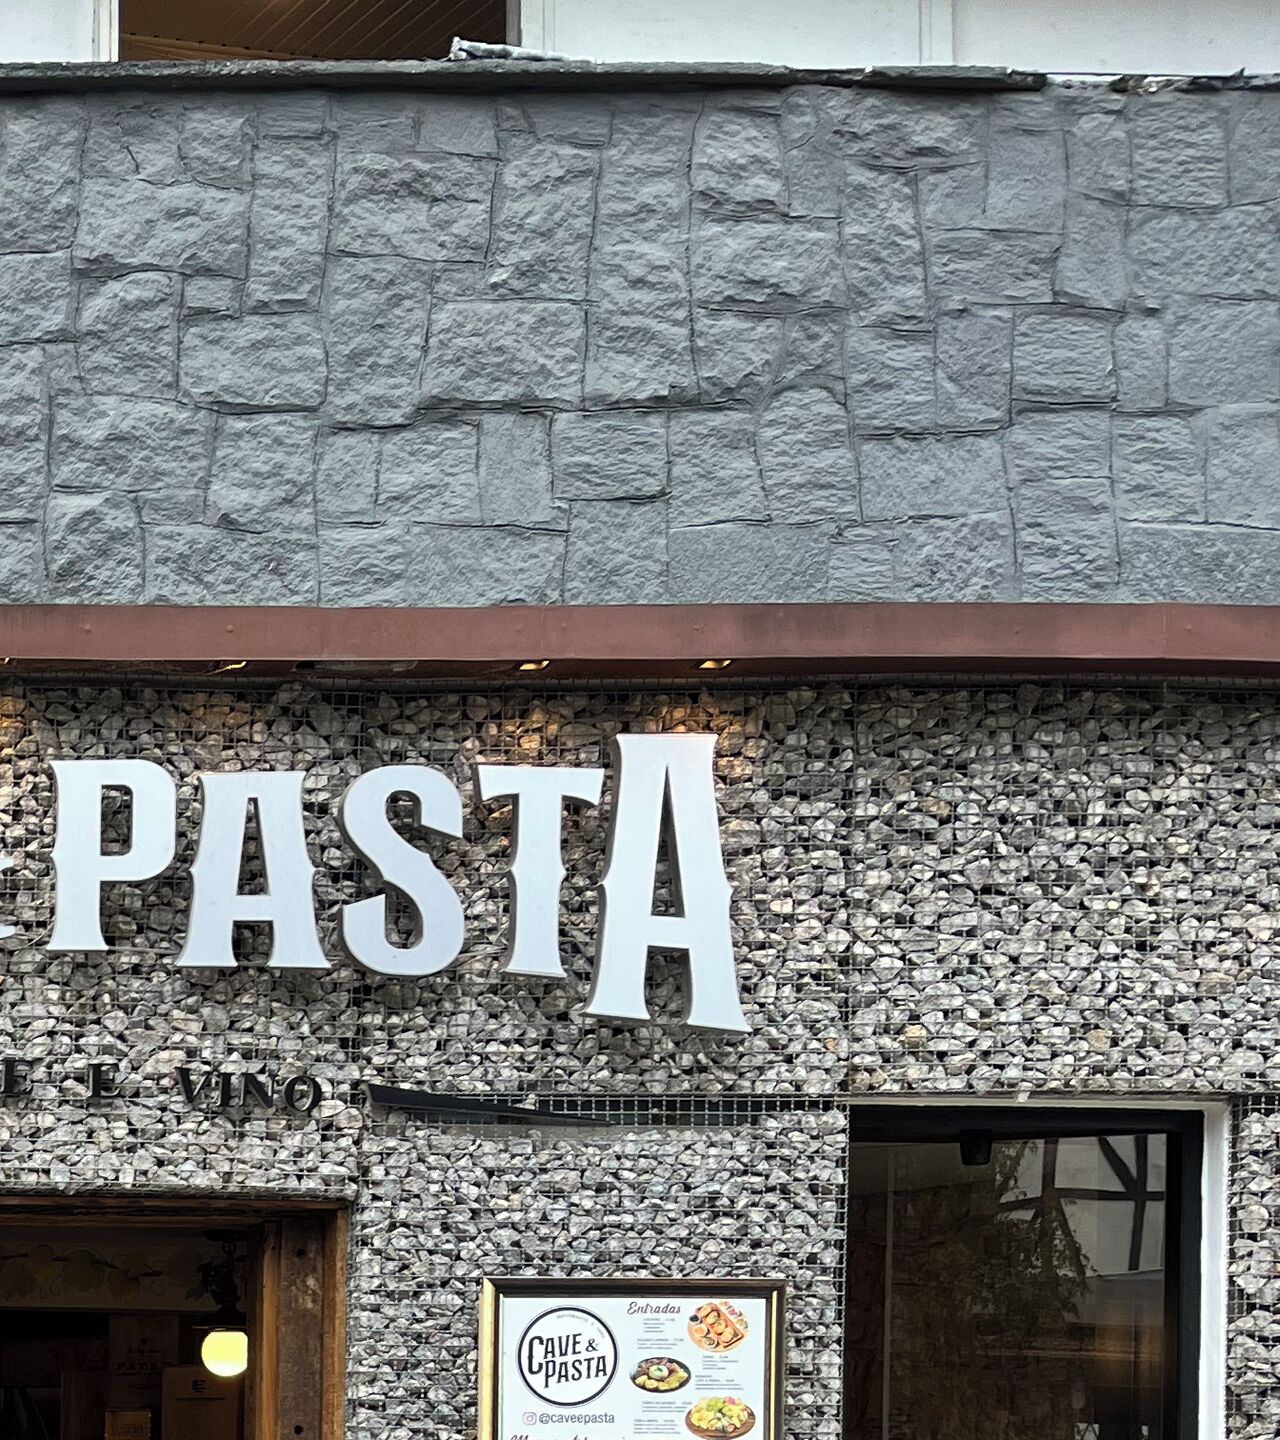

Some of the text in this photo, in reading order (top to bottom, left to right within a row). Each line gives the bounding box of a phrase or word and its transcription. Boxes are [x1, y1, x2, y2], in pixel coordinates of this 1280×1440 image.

[50, 732, 750, 1035] PASTA
[88, 1062, 122, 1100] E
[175, 1065, 323, 1114] VINO
[627, 1301, 681, 1315] Entradas
[528, 1333, 599, 1375] CAVE &
[544, 1355, 608, 1389] PASTA
[539, 1412, 615, 1425] @caveepasta
